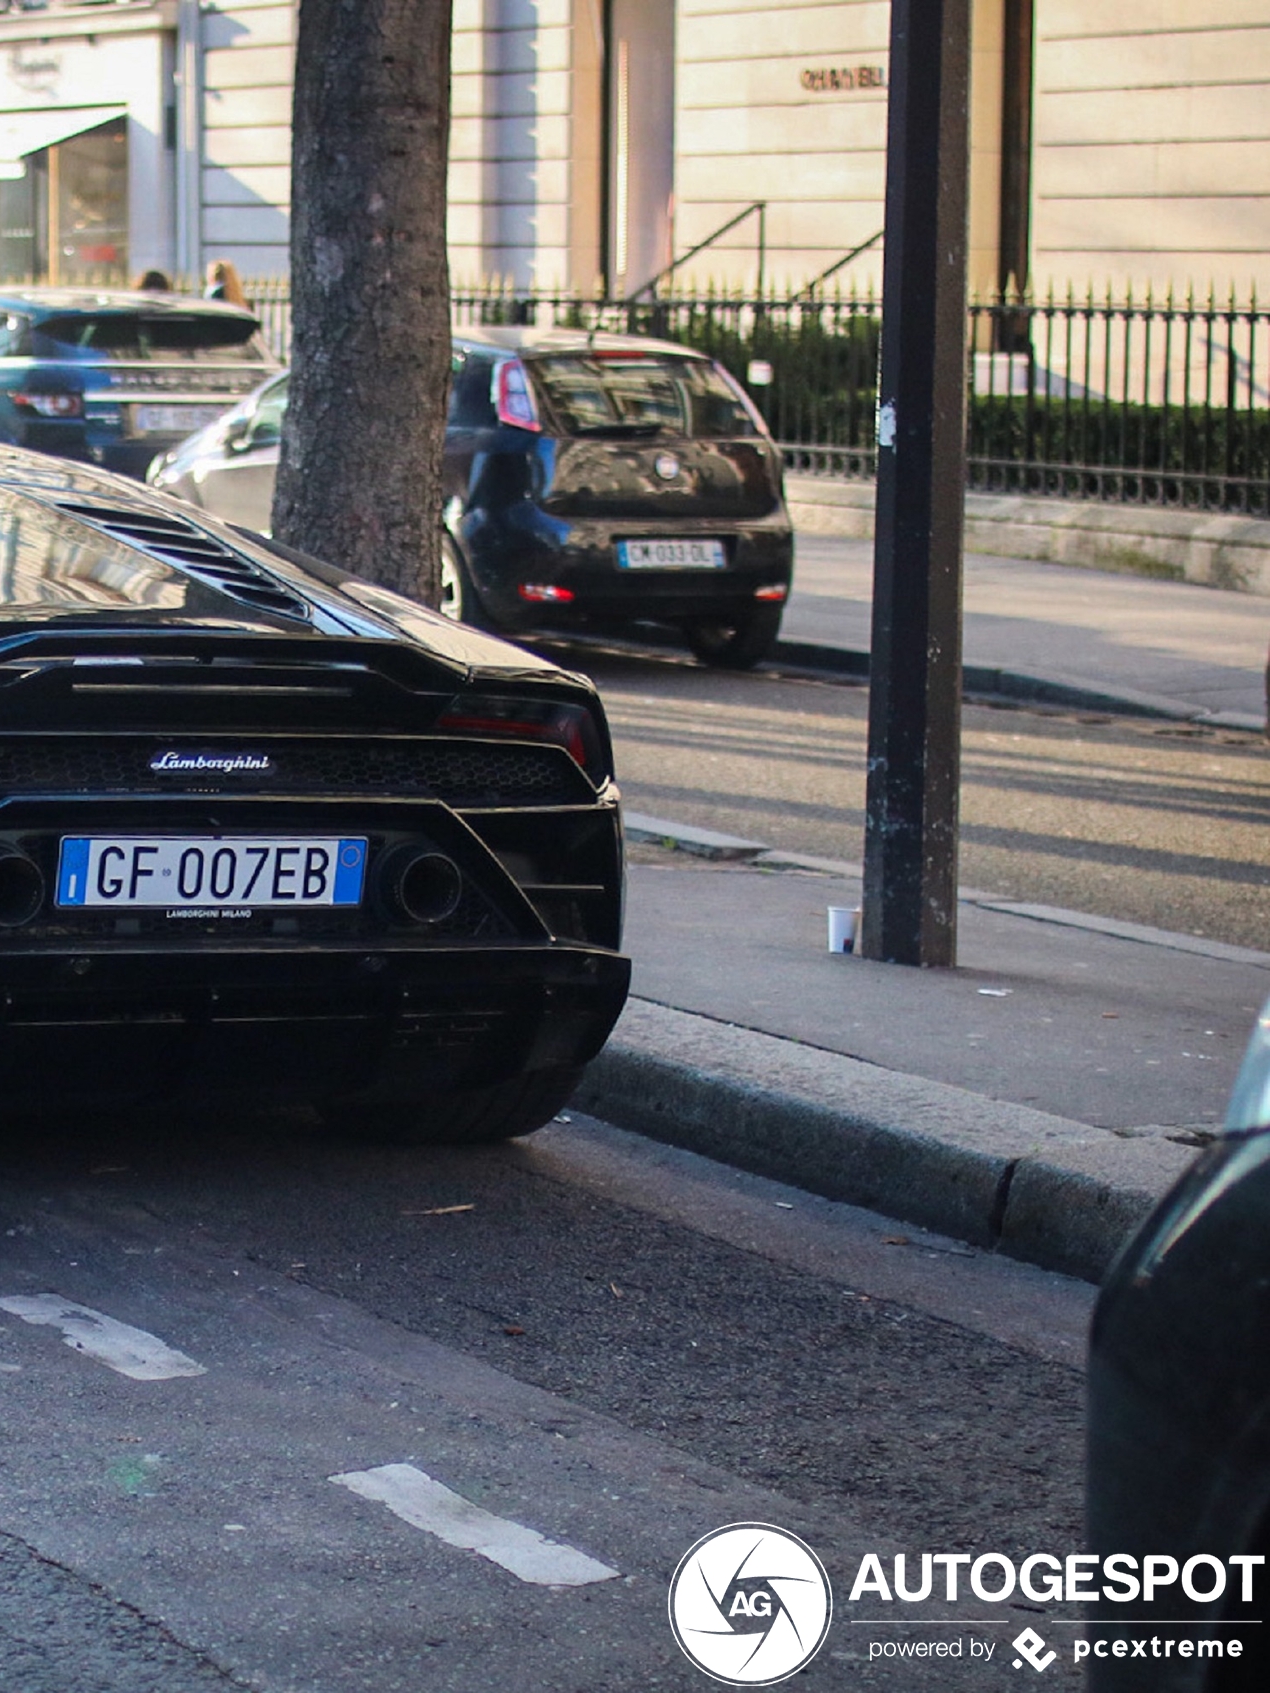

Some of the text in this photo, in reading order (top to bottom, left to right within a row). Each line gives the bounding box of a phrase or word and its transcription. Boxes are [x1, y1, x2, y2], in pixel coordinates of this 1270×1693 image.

[150, 752, 269, 772] Lamborghini
[166, 909, 252, 918] LAMBORGHINI MILANO
